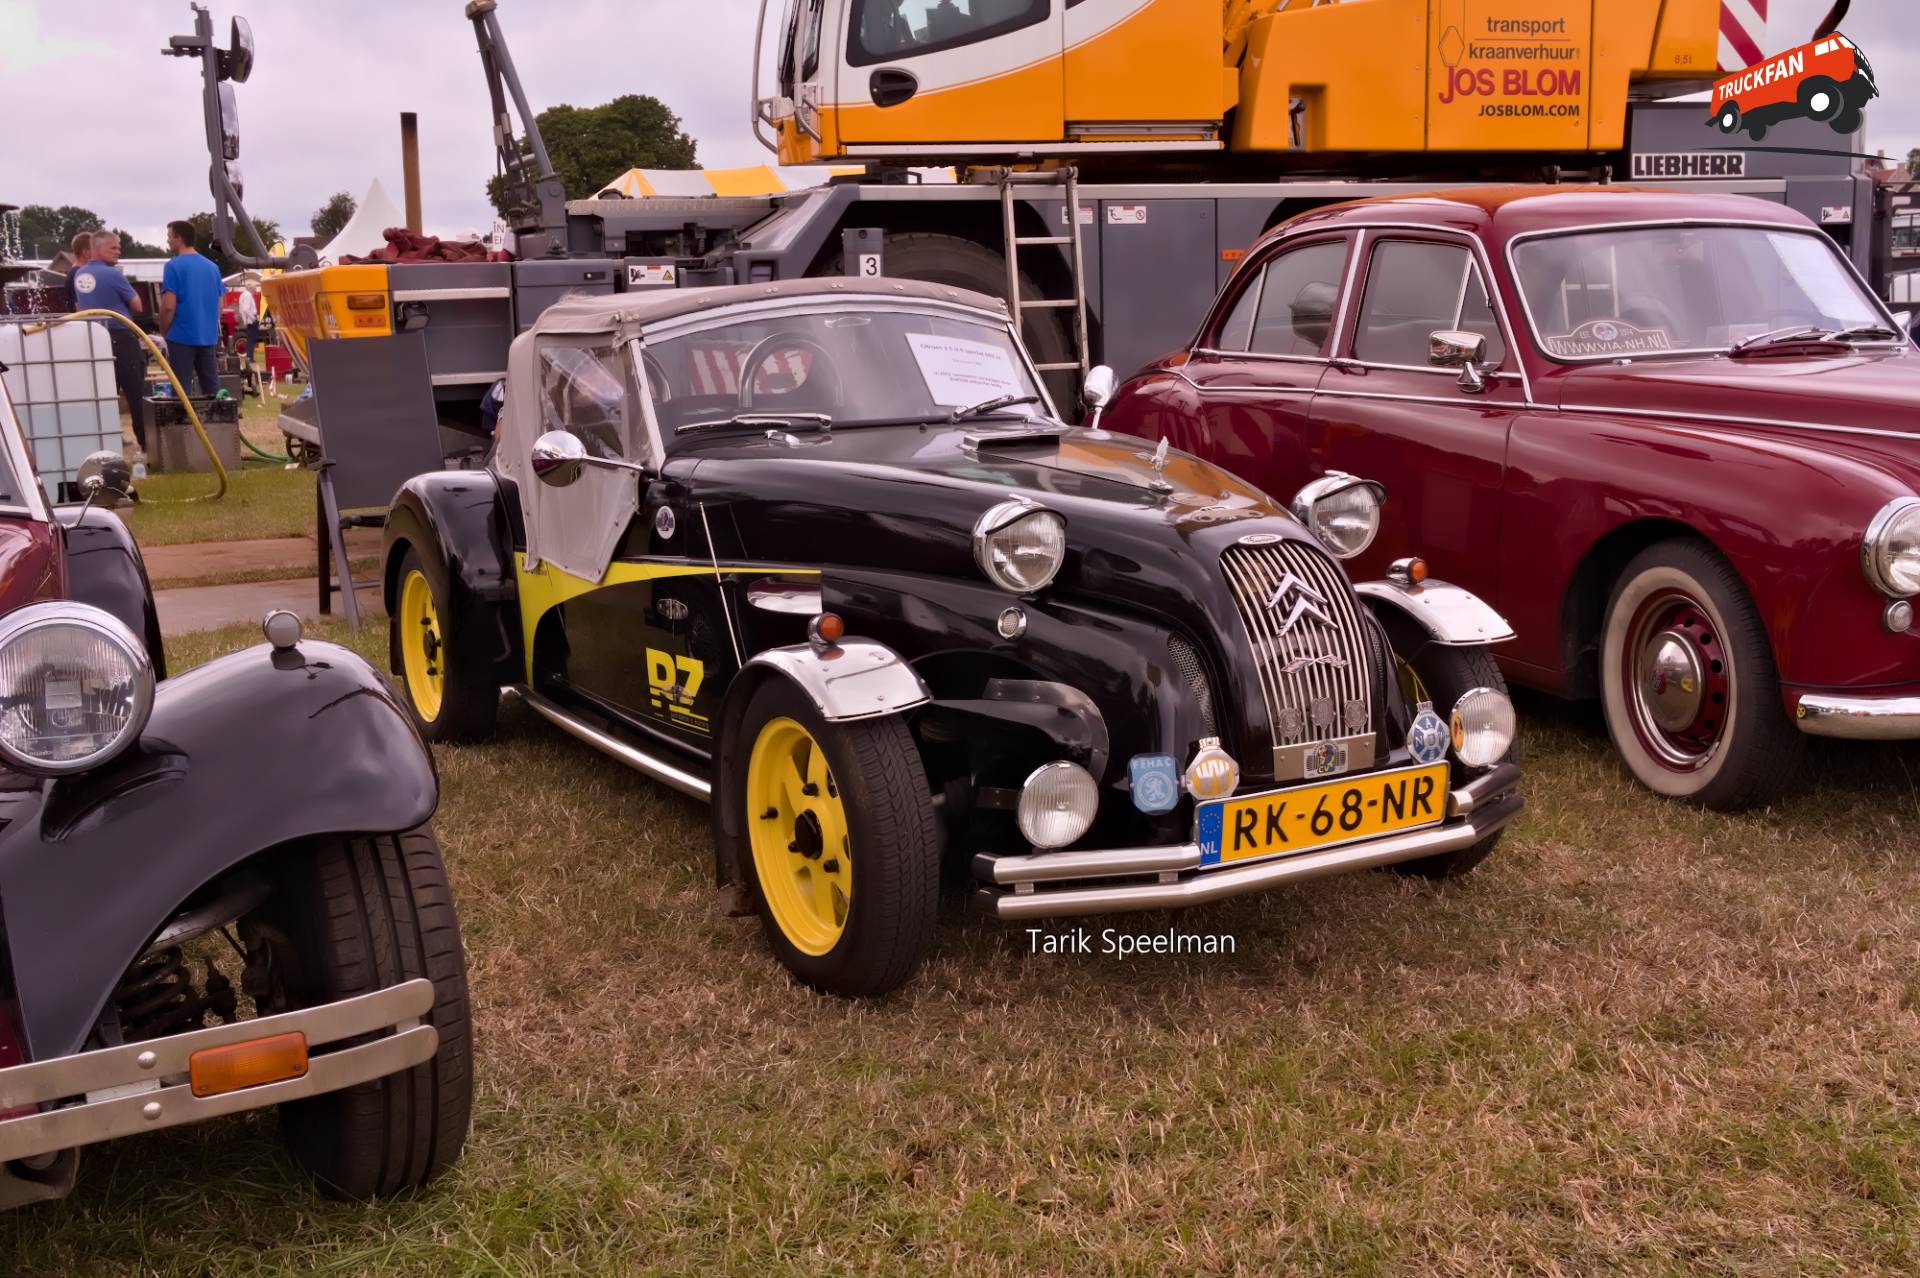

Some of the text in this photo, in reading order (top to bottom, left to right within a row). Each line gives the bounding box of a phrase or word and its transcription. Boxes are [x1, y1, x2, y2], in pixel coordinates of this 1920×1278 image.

[1487, 16, 1565, 37] transport
[1469, 43, 1575, 60] kraanverhuur
[1438, 65, 1581, 104] JOS BLOM
[1478, 104, 1580, 117] JOSBLOM.COM
[1634, 154, 1743, 177] LIEBHERR
[866, 256, 878, 276] 3
[1132, 758, 1172, 770] FEHAC
[1234, 774, 1435, 851] RK-68-NR
[1200, 841, 1219, 855] NL
